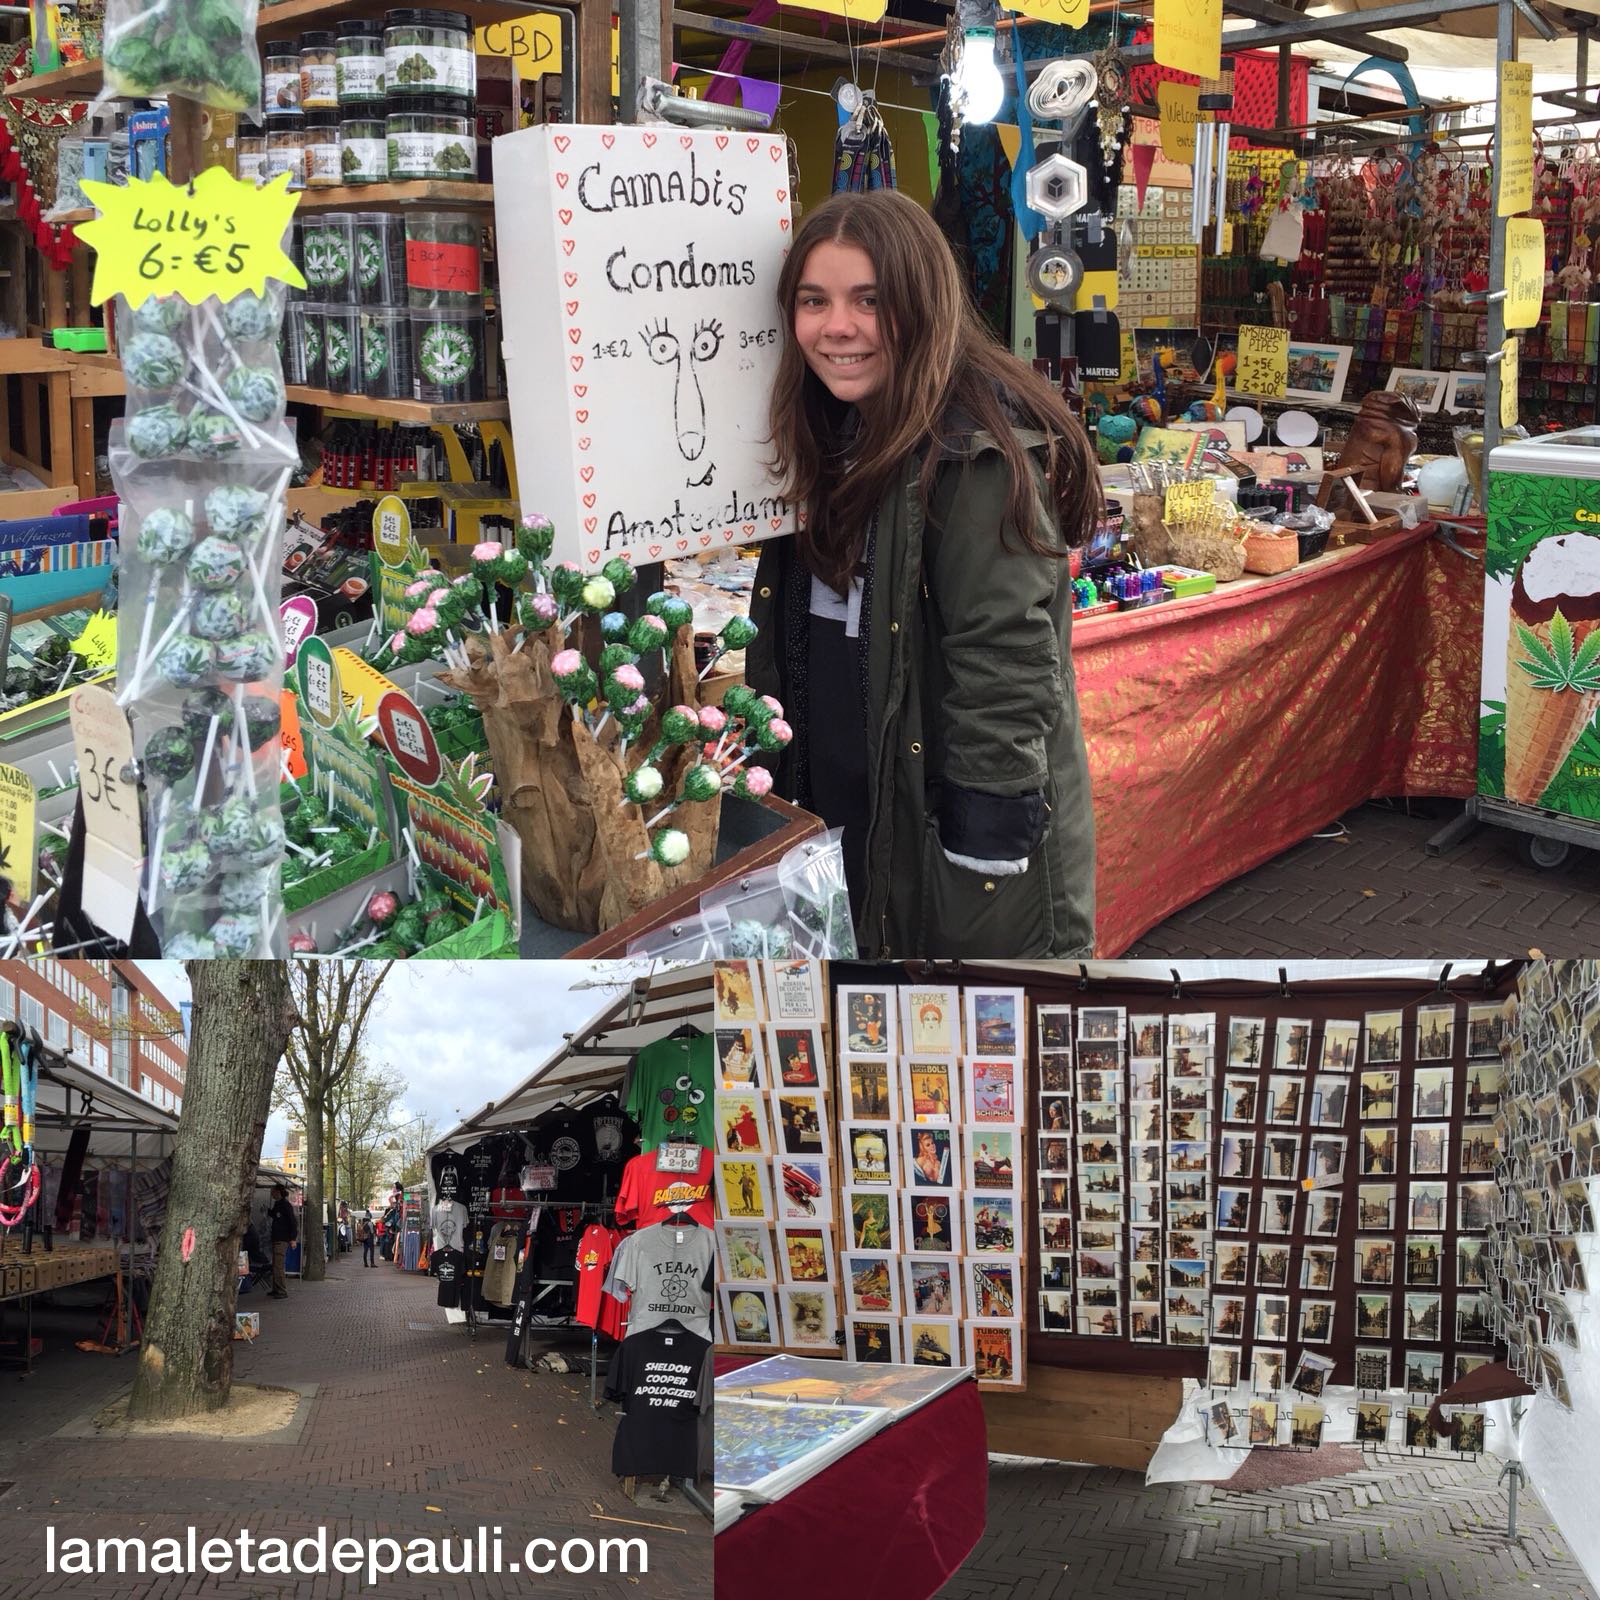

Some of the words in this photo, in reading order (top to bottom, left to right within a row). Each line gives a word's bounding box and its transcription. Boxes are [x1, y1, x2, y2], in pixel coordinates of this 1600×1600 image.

[484, 21, 553, 63] CBD
[1177, 133, 1198, 148] ente
[578, 151, 747, 215] Cannabis
[133, 207, 236, 240] Lolly's
[606, 242, 756, 294] Condoms
[1240, 326, 1288, 342] AMSTERDAM
[1249, 338, 1279, 353] PIPES
[1086, 368, 1119, 377] MARTENS
[604, 490, 790, 551] Amsterdam
[927, 1065, 947, 1074] BOLS
[653, 1185, 710, 1205] BAZINGA!
[653, 1261, 698, 1279] TEAM
[648, 1303, 696, 1315] SHELDON
[976, 1328, 1010, 1336] TUBORG
[644, 1362, 692, 1375] SHELDON
[646, 1374, 688, 1387] COOPER
[635, 1386, 697, 1400] APOLOGIZED
[649, 1398, 662, 1407] TO
[663, 1399, 680, 1408] ME
